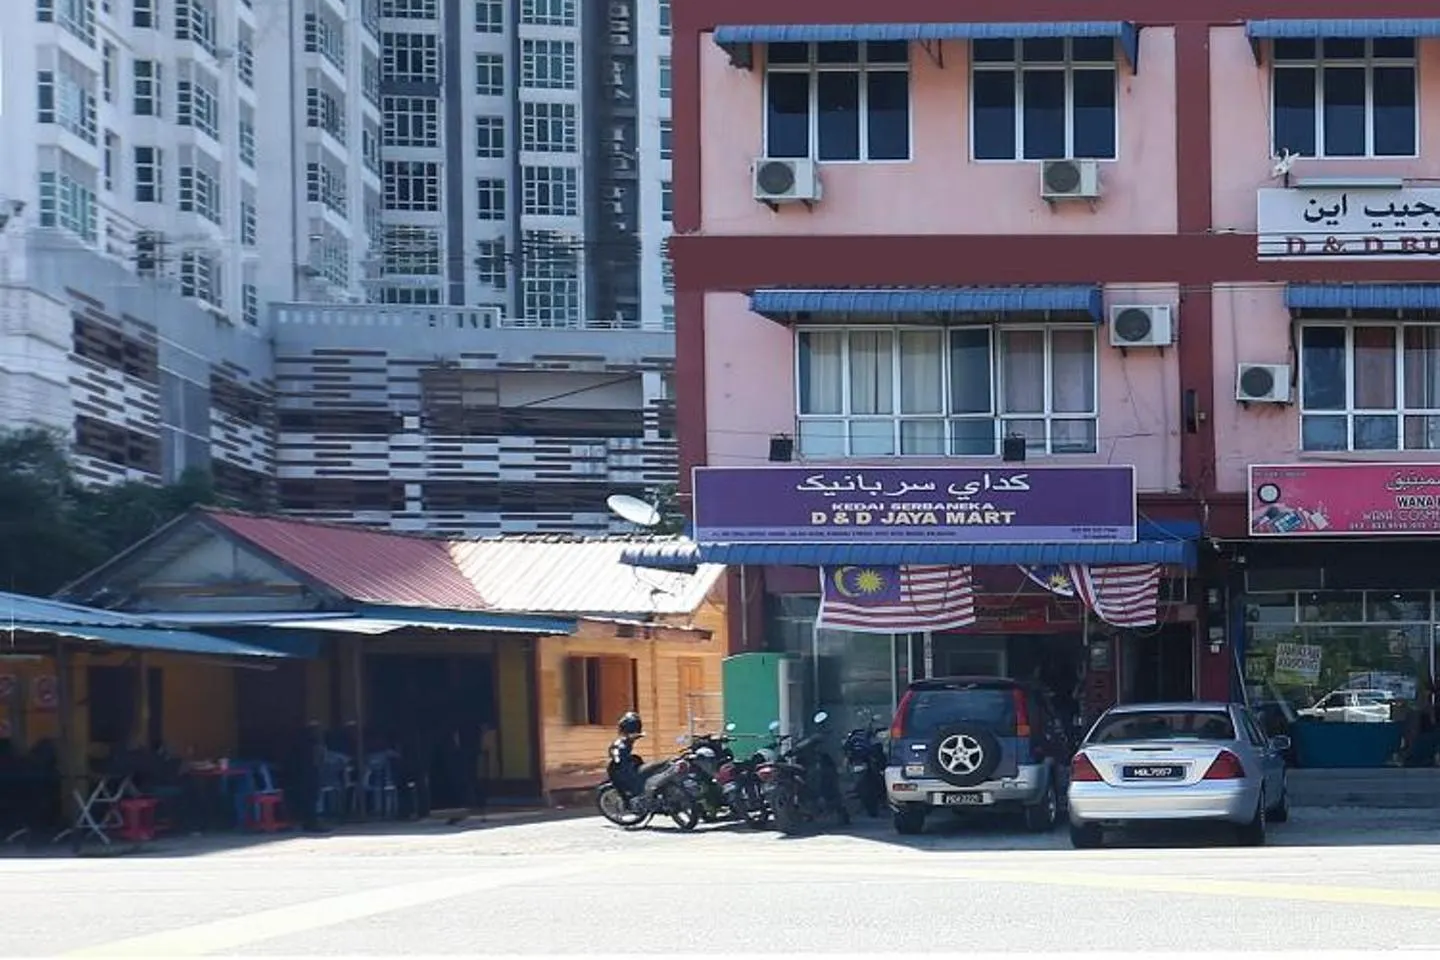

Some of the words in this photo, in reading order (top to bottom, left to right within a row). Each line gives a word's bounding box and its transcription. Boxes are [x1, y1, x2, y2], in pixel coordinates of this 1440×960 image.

[1286, 236, 1306, 253] D
[1323, 236, 1347, 253] &
[832, 502, 885, 511] KEDAI
[890, 502, 995, 511] SERBANEKA
[1396, 495, 1436, 509] WANA
[811, 511, 828, 525] D
[833, 511, 850, 525] &
[856, 511, 873, 525] D
[881, 511, 938, 525] JAYA
[946, 511, 1017, 525] MART
